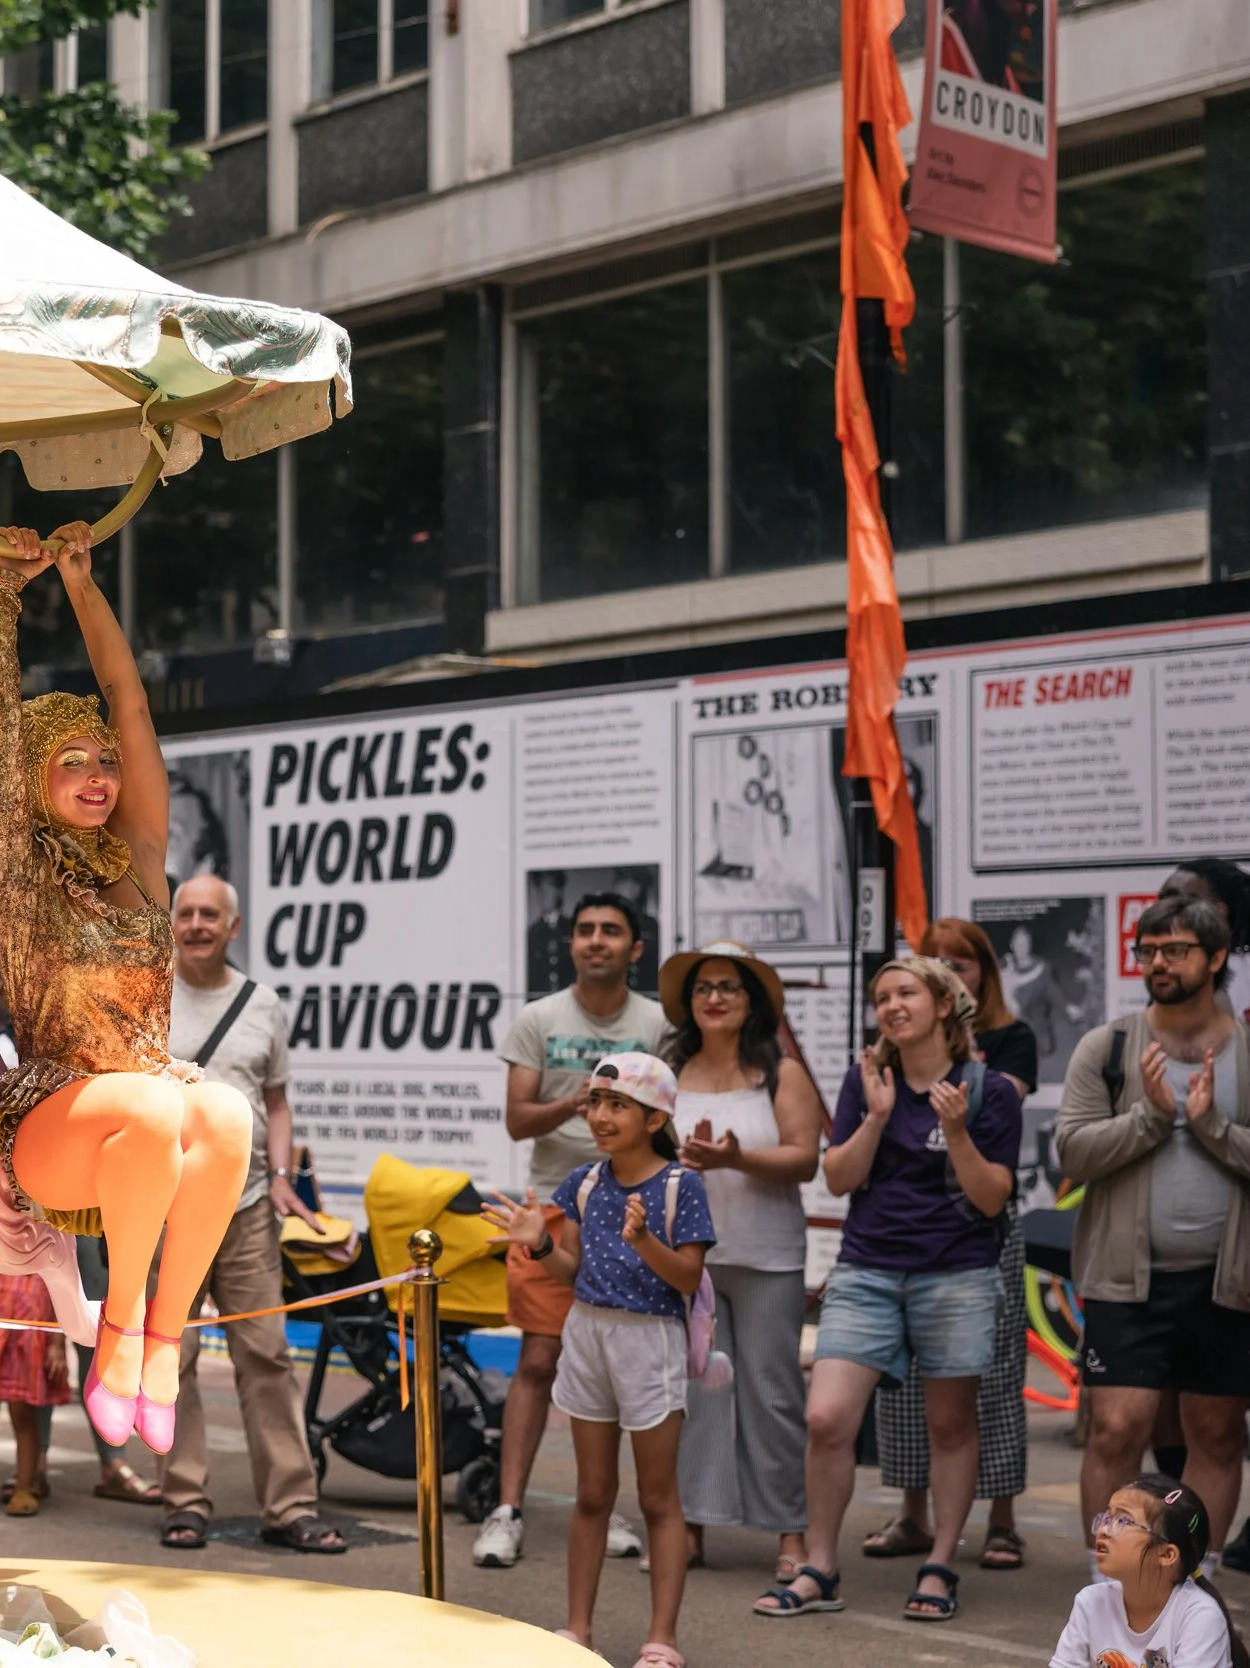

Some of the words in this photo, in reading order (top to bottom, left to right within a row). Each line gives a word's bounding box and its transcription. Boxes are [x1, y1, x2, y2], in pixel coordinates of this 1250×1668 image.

[937, 81, 1044, 147] CROYDON
[693, 691, 759, 720] THE
[771, 672, 938, 712] ROBRY
[983, 677, 1026, 711] THE
[1033, 666, 1135, 706] SEARCH
[263, 722, 491, 808] PICKLES:
[268, 811, 456, 888] WORLD
[265, 901, 367, 970] CUP
[859, 885, 874, 948] 007
